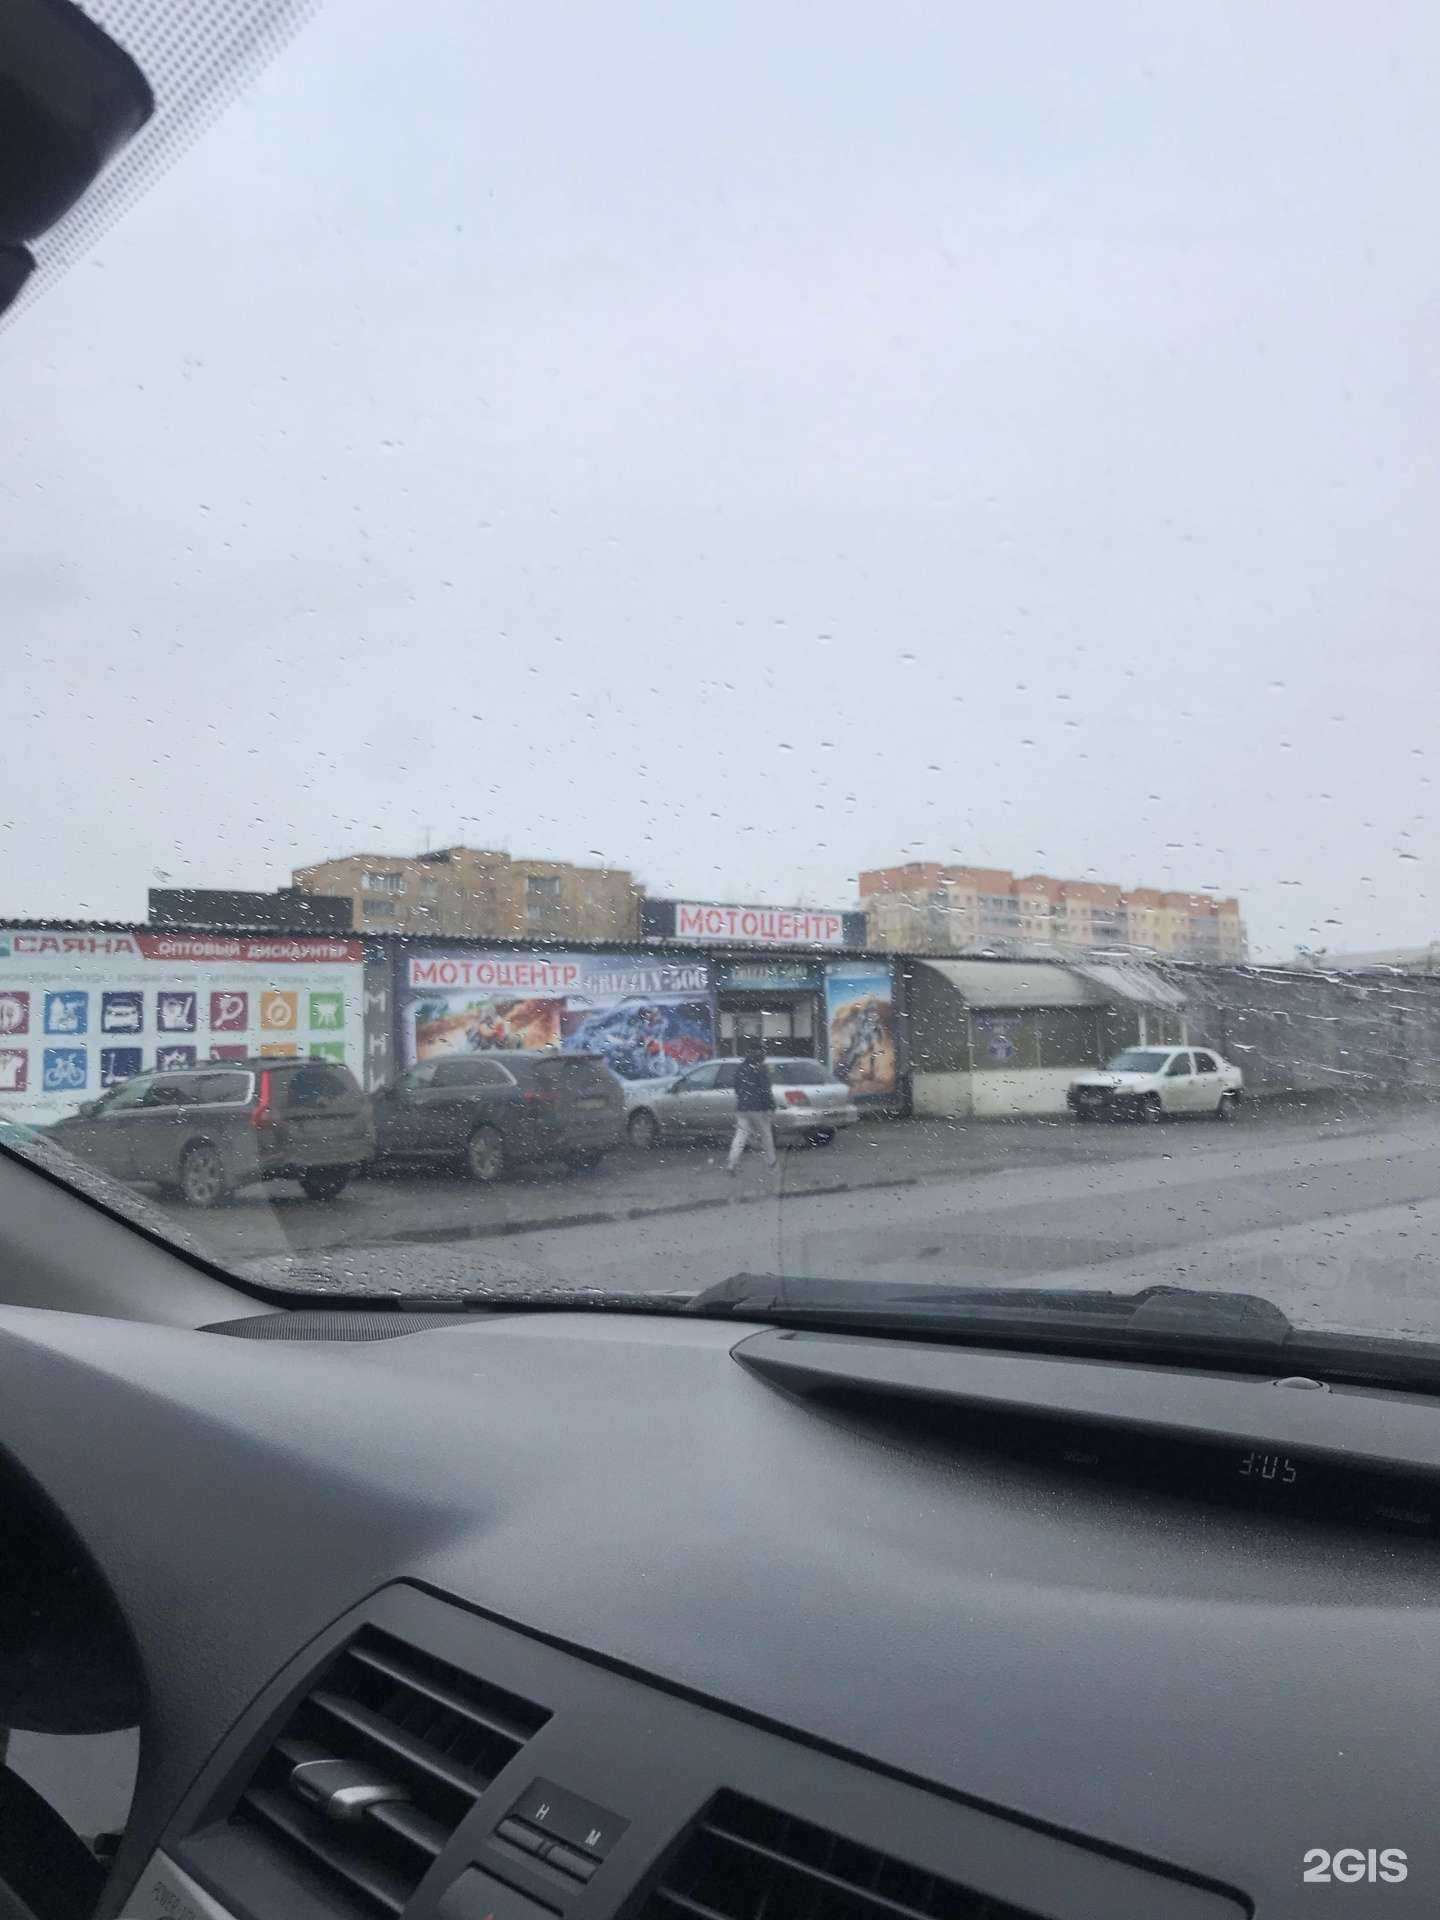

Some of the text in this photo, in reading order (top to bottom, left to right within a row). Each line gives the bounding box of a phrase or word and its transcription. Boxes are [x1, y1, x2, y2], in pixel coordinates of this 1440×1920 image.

[680, 907, 839, 940] МОТОЦЕНТР
[14, 936, 135, 955] САЯНА
[412, 960, 577, 987] МОТОЦЕНТР
[536, 1803, 601, 1846] H M
